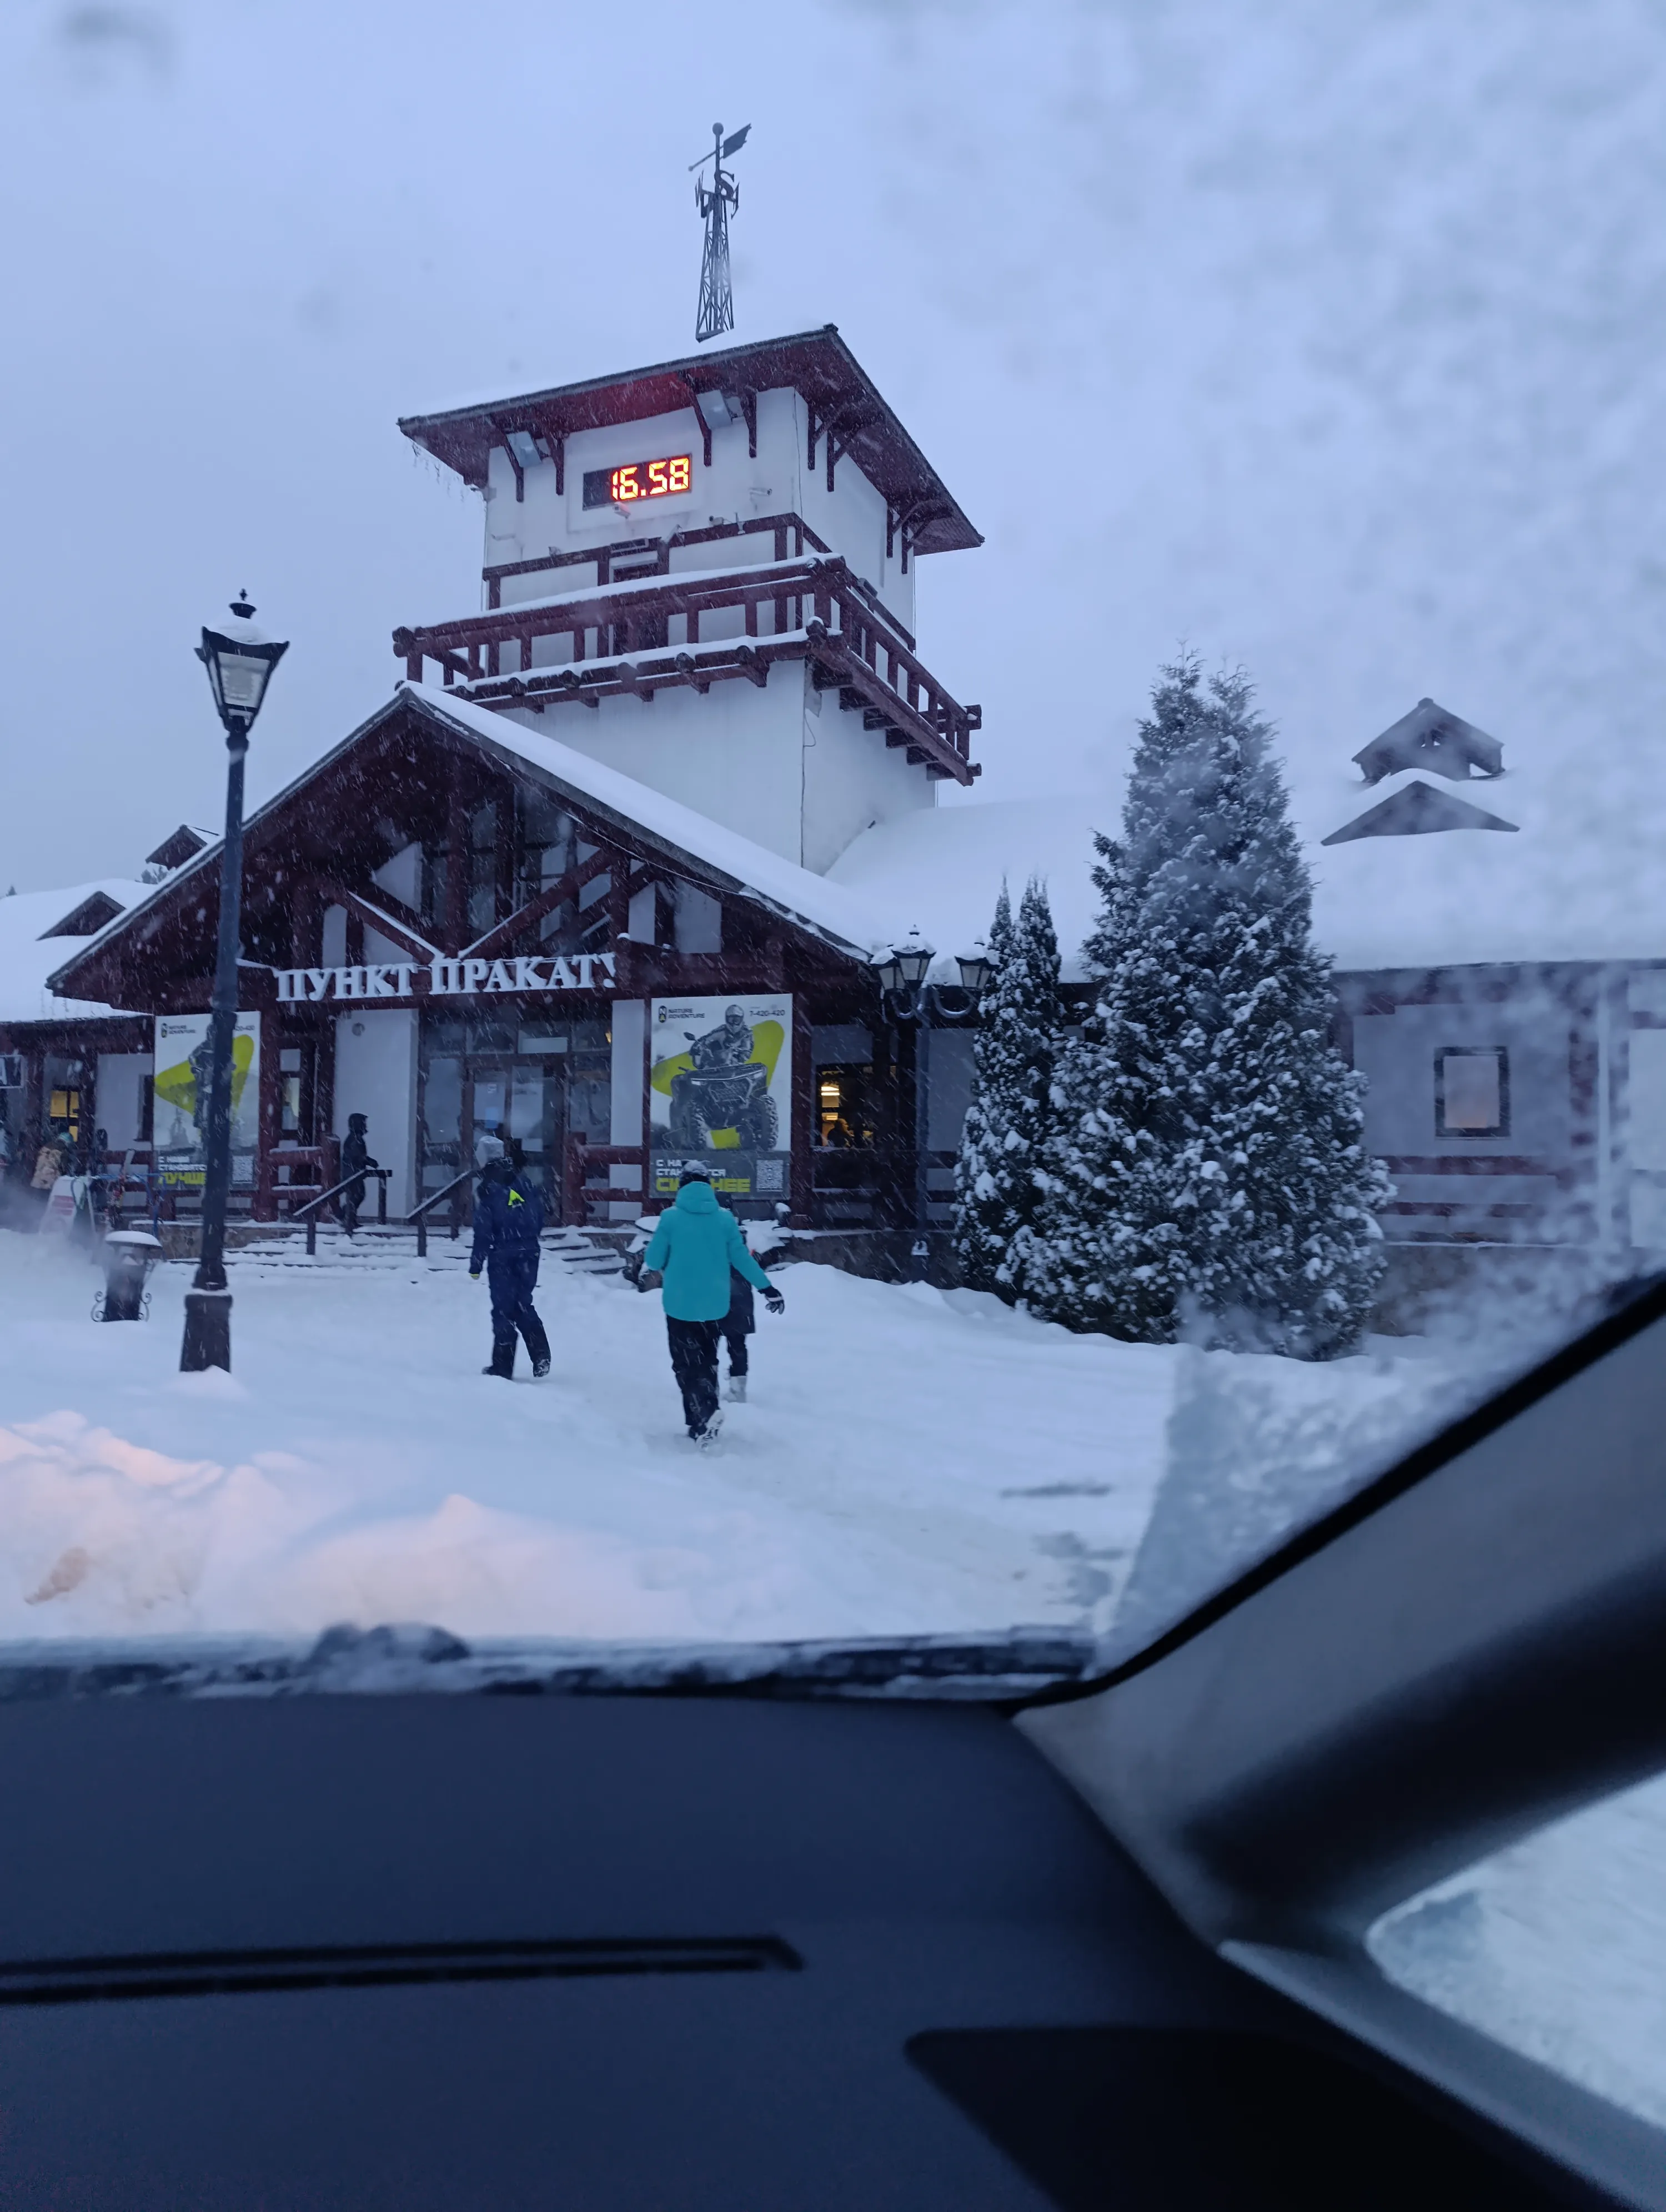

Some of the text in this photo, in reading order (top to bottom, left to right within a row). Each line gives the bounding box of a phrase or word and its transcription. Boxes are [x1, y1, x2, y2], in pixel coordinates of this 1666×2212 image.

[613, 458, 689, 500] 16.58
[276, 952, 616, 1001] ПУНКТ ПРАКАТ!
[656, 1178, 750, 1192] СИНЕЕ
